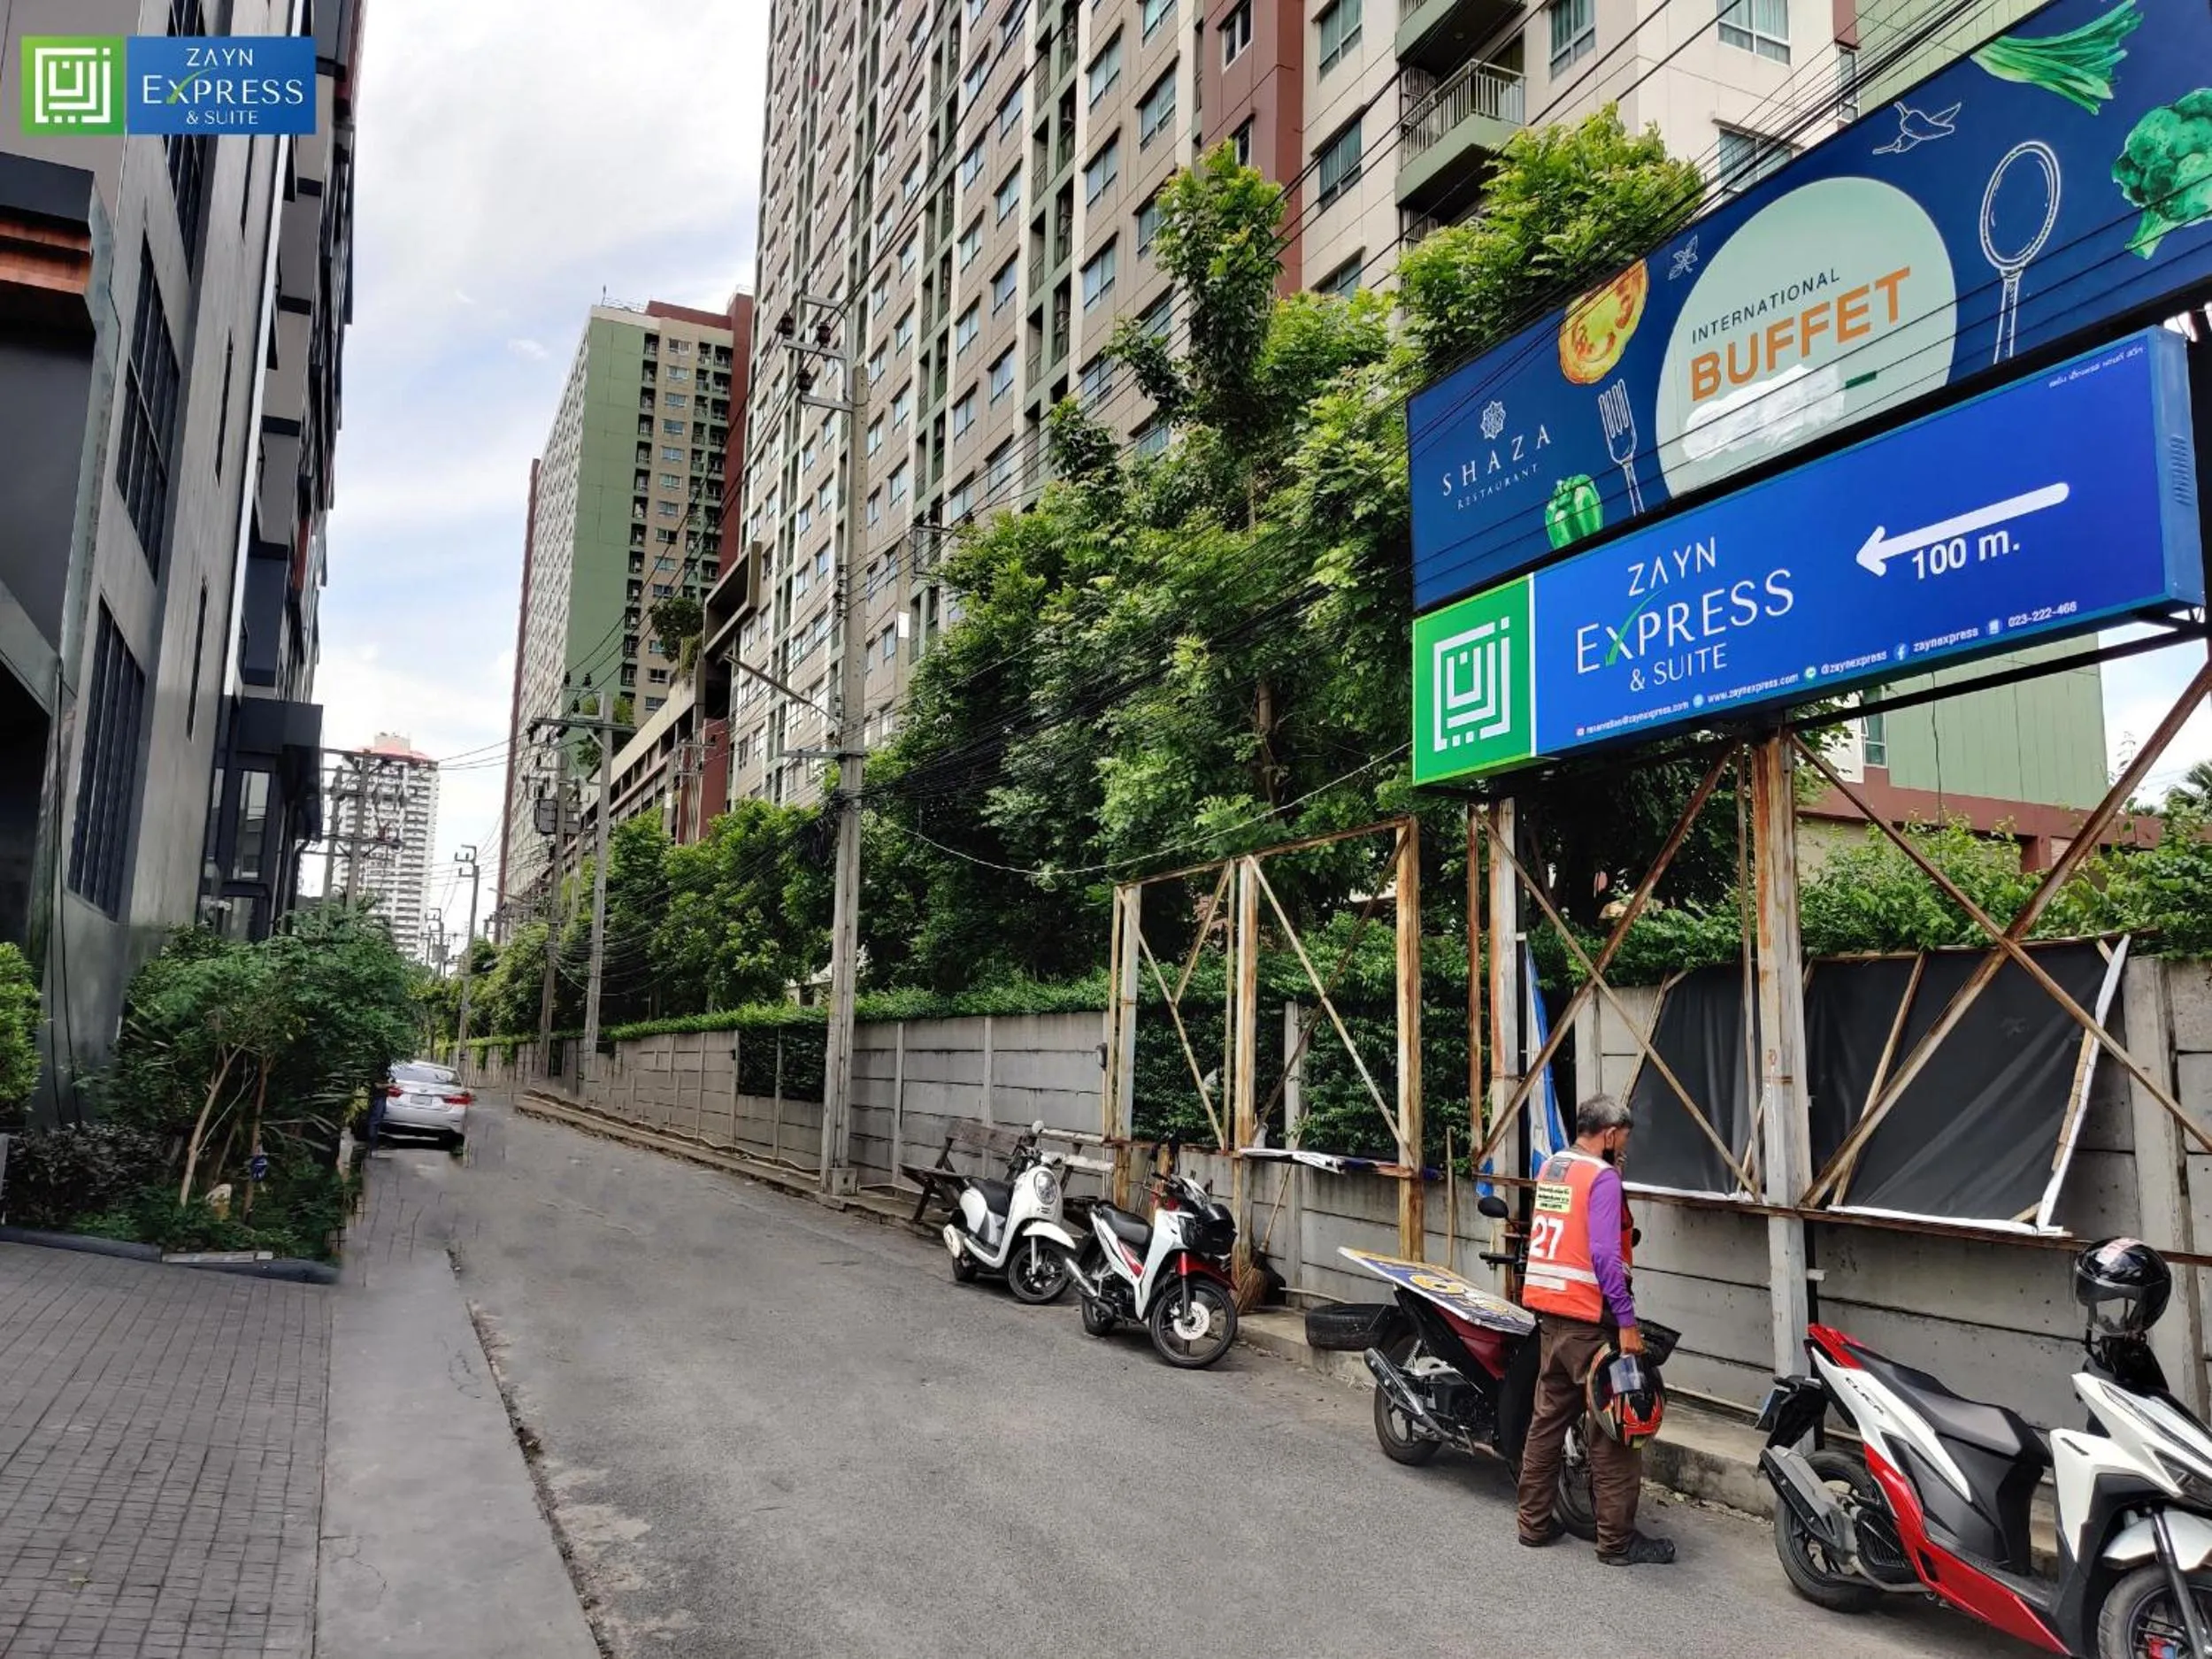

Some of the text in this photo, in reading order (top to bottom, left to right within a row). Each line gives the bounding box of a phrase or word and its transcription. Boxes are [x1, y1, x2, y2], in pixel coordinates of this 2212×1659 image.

[1691, 265, 1911, 402] BUFFET
[1692, 268, 1840, 344] INTERNATIONAL
[1442, 424, 1551, 496] SHAZA
[1457, 463, 1538, 511] RESTAURANT
[1627, 536, 1717, 597] ZAYN
[1911, 529, 2021, 580] 100 m.
[1576, 568, 1794, 674] EXPRESS
[1912, 626, 1979, 653] zaynexpress
[1630, 642, 1727, 692] & SUITE
[1529, 1214, 1565, 1261] 27
